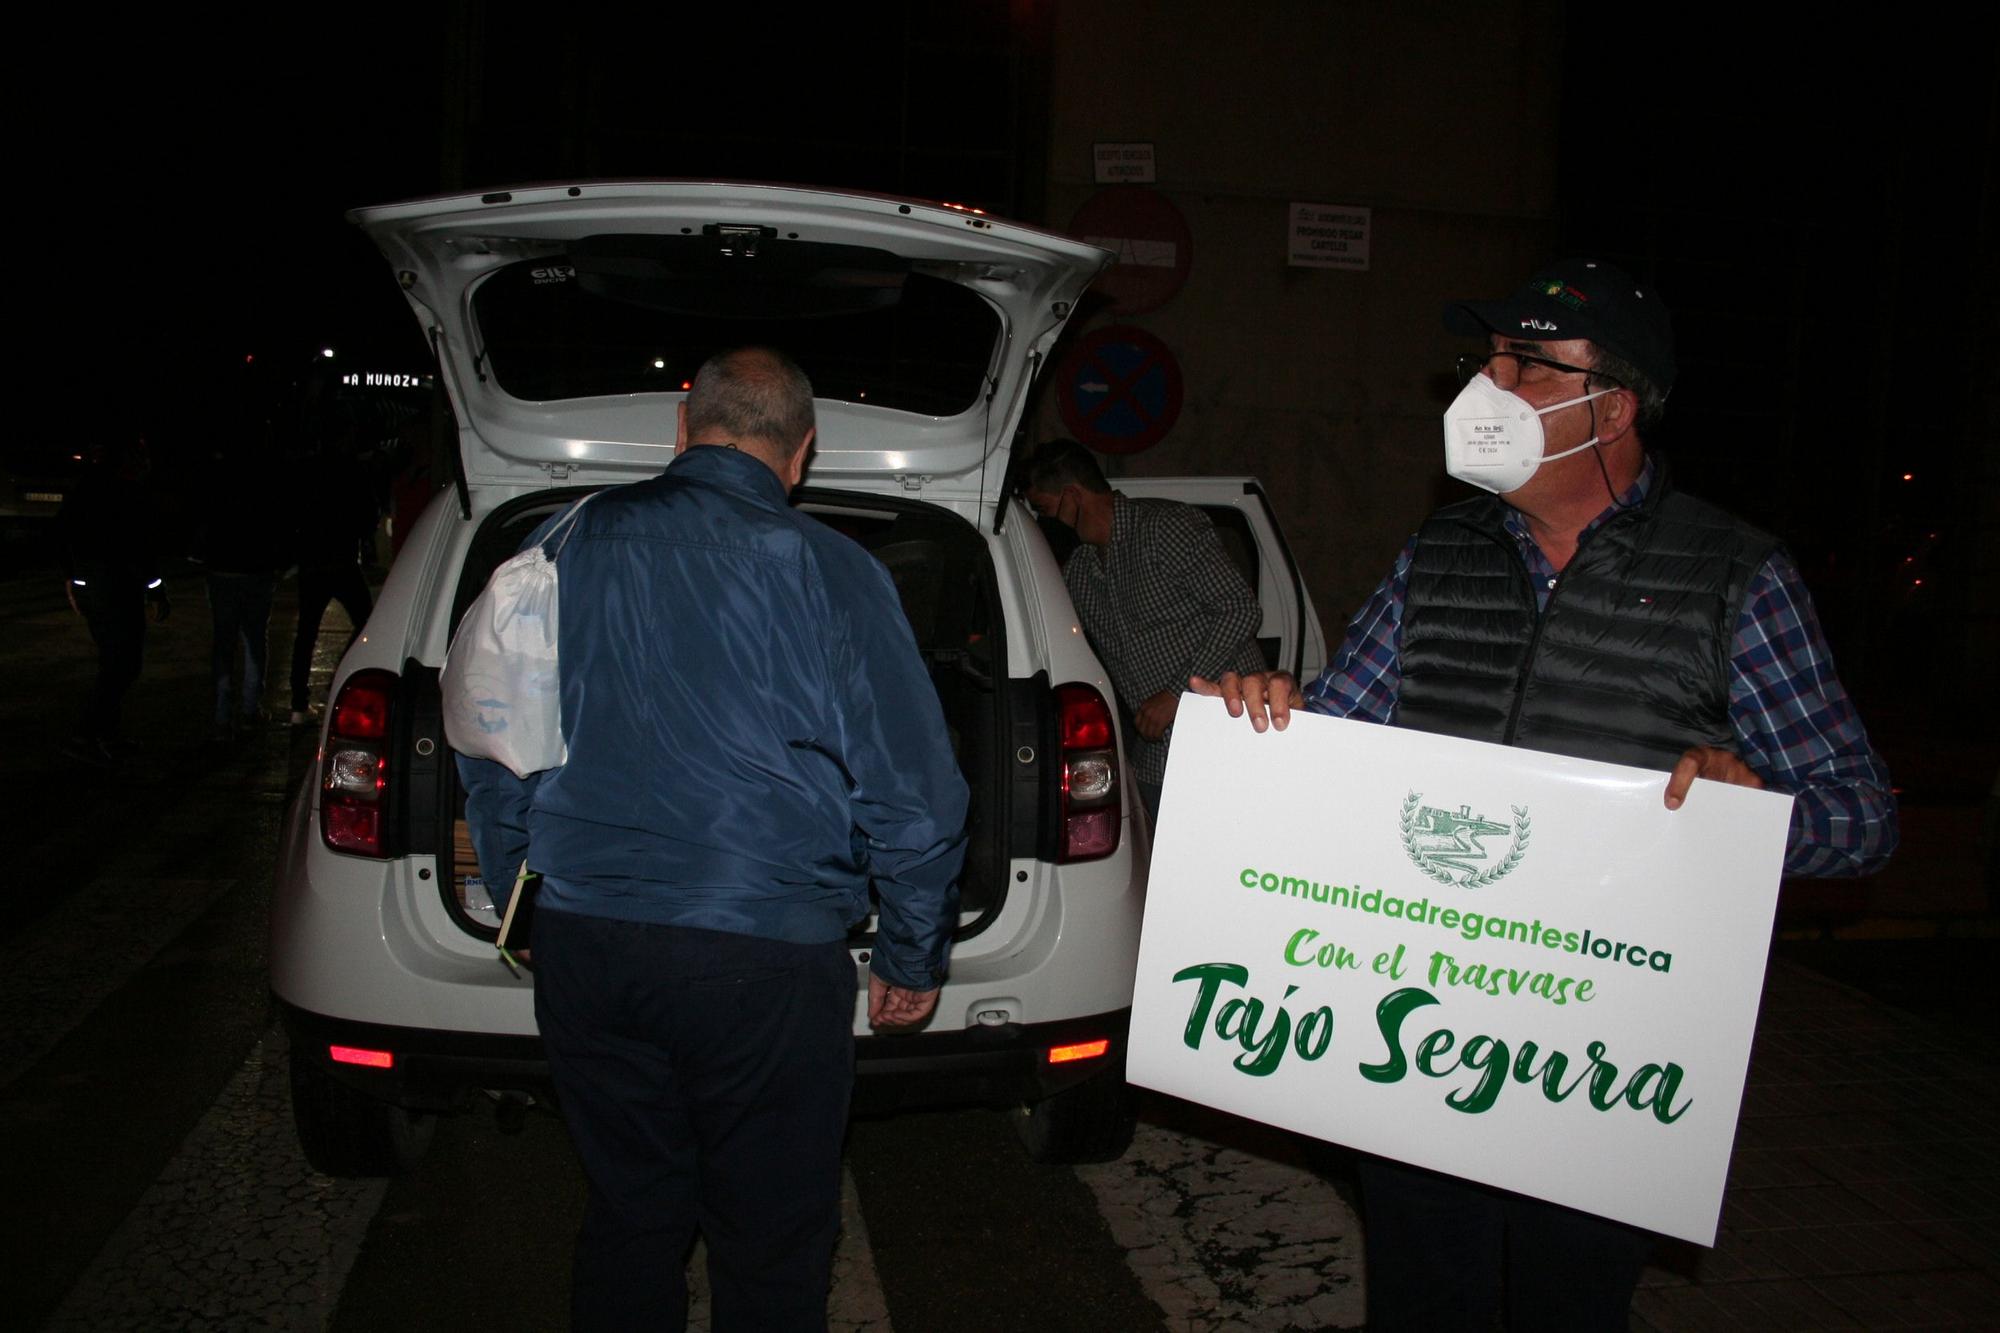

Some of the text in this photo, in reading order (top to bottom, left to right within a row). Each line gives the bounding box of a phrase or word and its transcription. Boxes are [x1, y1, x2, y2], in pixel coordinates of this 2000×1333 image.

[1296, 226, 1337, 239] PROHIBIDO
[1310, 239, 1348, 252] CARTELES
[1520, 319, 1558, 331] FILA
[1239, 866, 1673, 973] comunidadreganteslorca
[1284, 927, 1596, 1005] Con el Trasvase
[1172, 962, 1693, 1124] Tajo Segura
